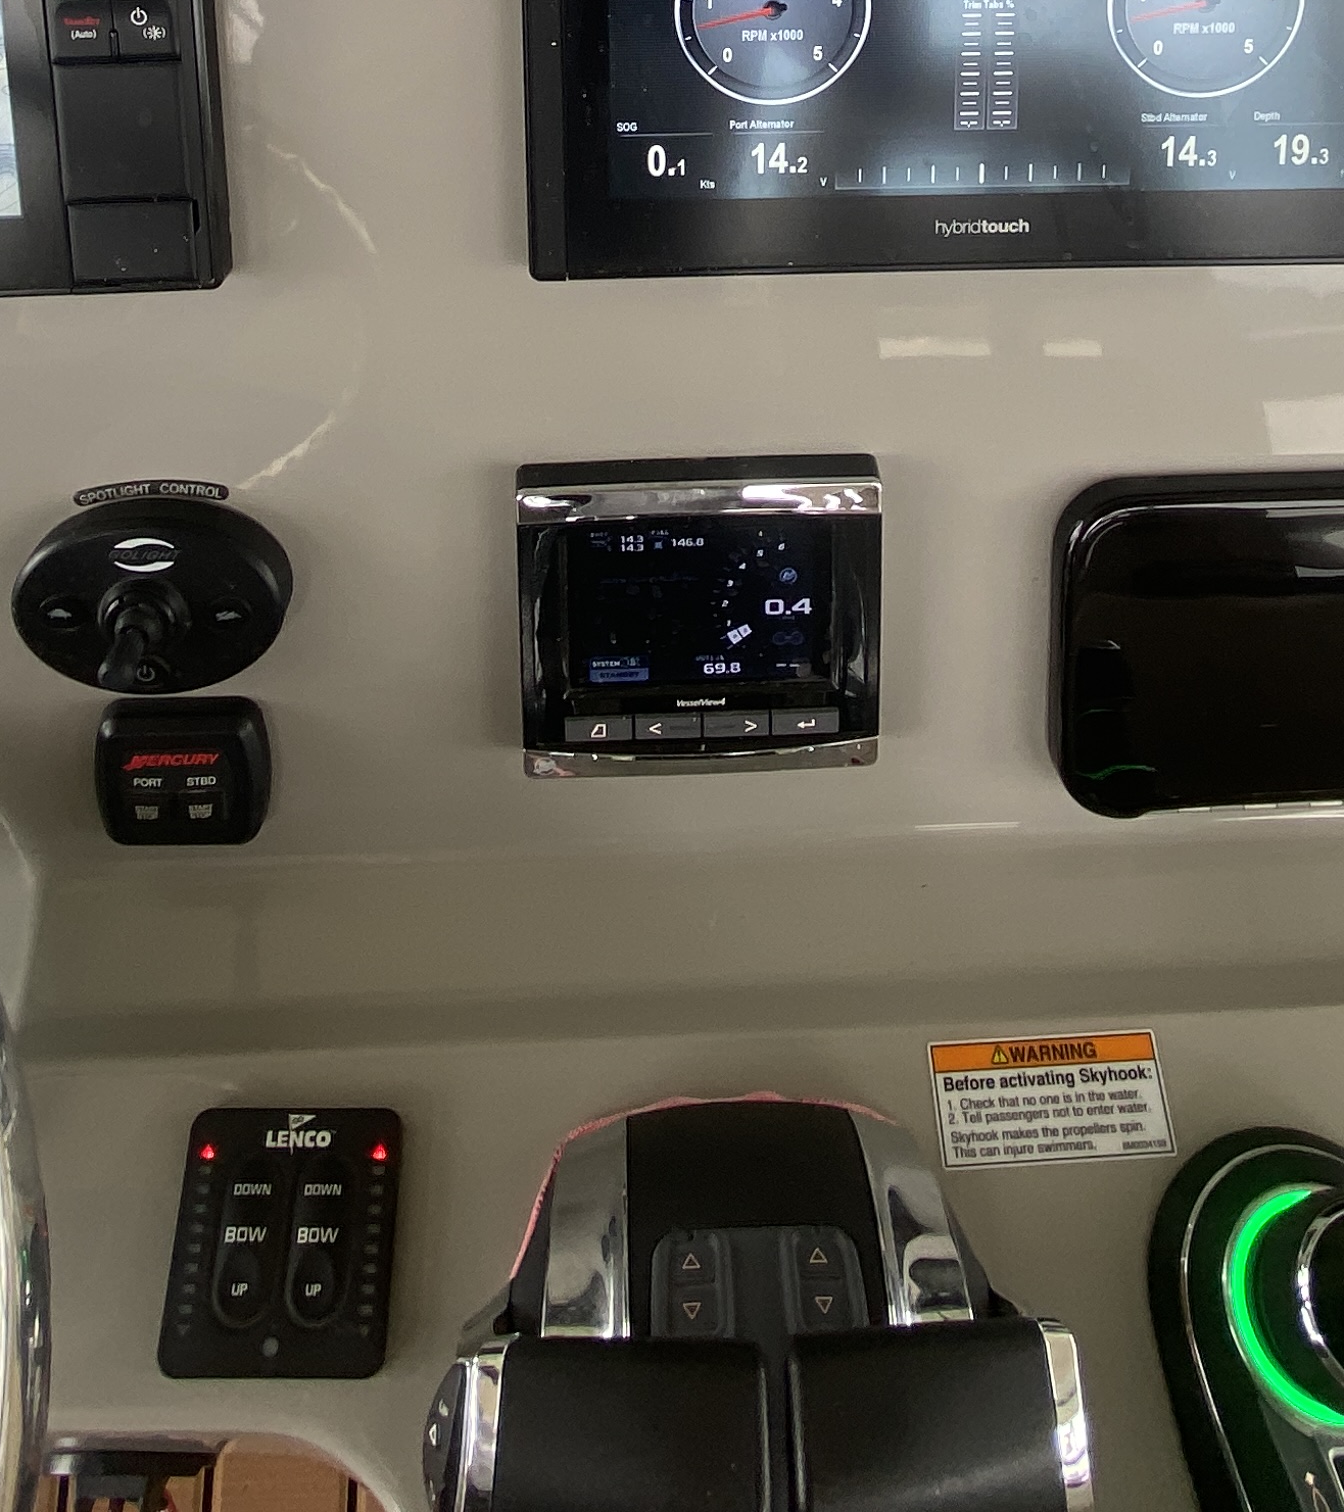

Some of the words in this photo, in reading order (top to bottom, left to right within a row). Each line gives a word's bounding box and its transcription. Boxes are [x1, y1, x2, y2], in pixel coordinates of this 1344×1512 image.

[984, 0, 1003, 9] Tabs
[741, 29, 768, 42] RPM
[770, 29, 804, 42] x1000
[1172, 21, 1199, 35] RPM
[1201, 21, 1236, 35] x1000
[812, 46, 823, 62] 5
[1152, 39, 1164, 56] 0
[1243, 38, 1254, 55] 5
[722, 48, 733, 63] 0
[729, 119, 748, 131] Port
[749, 118, 795, 131] Alternator
[1163, 110, 1208, 124] Alternator
[1253, 110, 1281, 124] Depth
[616, 121, 638, 133] SOG
[1160, 135, 1218, 168] 14.3
[1272, 133, 1330, 167] 19.3
[646, 144, 687, 178] 0.1
[750, 142, 809, 175] 14.2
[819, 176, 828, 188] V
[1228, 169, 1236, 180] V
[699, 179, 716, 190] Kts
[933, 218, 1030, 236] hybridtouch
[78, 483, 152, 506] SPOTLIGHT
[158, 483, 224, 499] CONTROL
[619, 535, 645, 544] 14.3
[619, 544, 645, 552] 14.3
[763, 596, 812, 616] 0.4
[702, 661, 742, 675] 69.8
[121, 752, 220, 772] MERCURY
[133, 776, 163, 788] PORT
[186, 775, 217, 787] STBD
[1008, 1041, 1098, 1064] WARNING
[942, 1074, 996, 1093] Before
[998, 1070, 1076, 1089] activating
[1079, 1064, 1154, 1087] Skyhook:
[947, 1098, 957, 1111] 1.
[959, 1096, 995, 1111] Check
[997, 1094, 1019, 1108] that
[1022, 1095, 1037, 1107] no
[1039, 1093, 1060, 1105] one
[1062, 1091, 1073, 1104] is
[1074, 1090, 1086, 1103] in
[1087, 1089, 1106, 1103] the
[1107, 1088, 1143, 1102] water.
[947, 1113, 960, 1126] 2.
[961, 1110, 982, 1125] Tell
[984, 1108, 1051, 1127] passengers
[1053, 1106, 1070, 1119] not
[1072, 1104, 1084, 1118] to
[1086, 1103, 1115, 1117] enter
[264, 1129, 333, 1150] LENCO
[950, 1129, 999, 1148] Skyhook
[1001, 1126, 1039, 1141] makes
[1041, 1126, 1059, 1139] the
[1061, 1122, 1118, 1141] propellers
[1119, 1119, 1146, 1136] spin.
[951, 1144, 978, 1159] This
[979, 1144, 1001, 1158] can
[1002, 1140, 1035, 1159] injure
[1037, 1139, 1098, 1155] swimmers.
[232, 1183, 273, 1197] DOWN
[303, 1183, 342, 1197] DOWN
[223, 1226, 268, 1244] BOW
[296, 1227, 340, 1244] BOW
[230, 1282, 249, 1297] UP
[305, 1283, 323, 1297] UP
